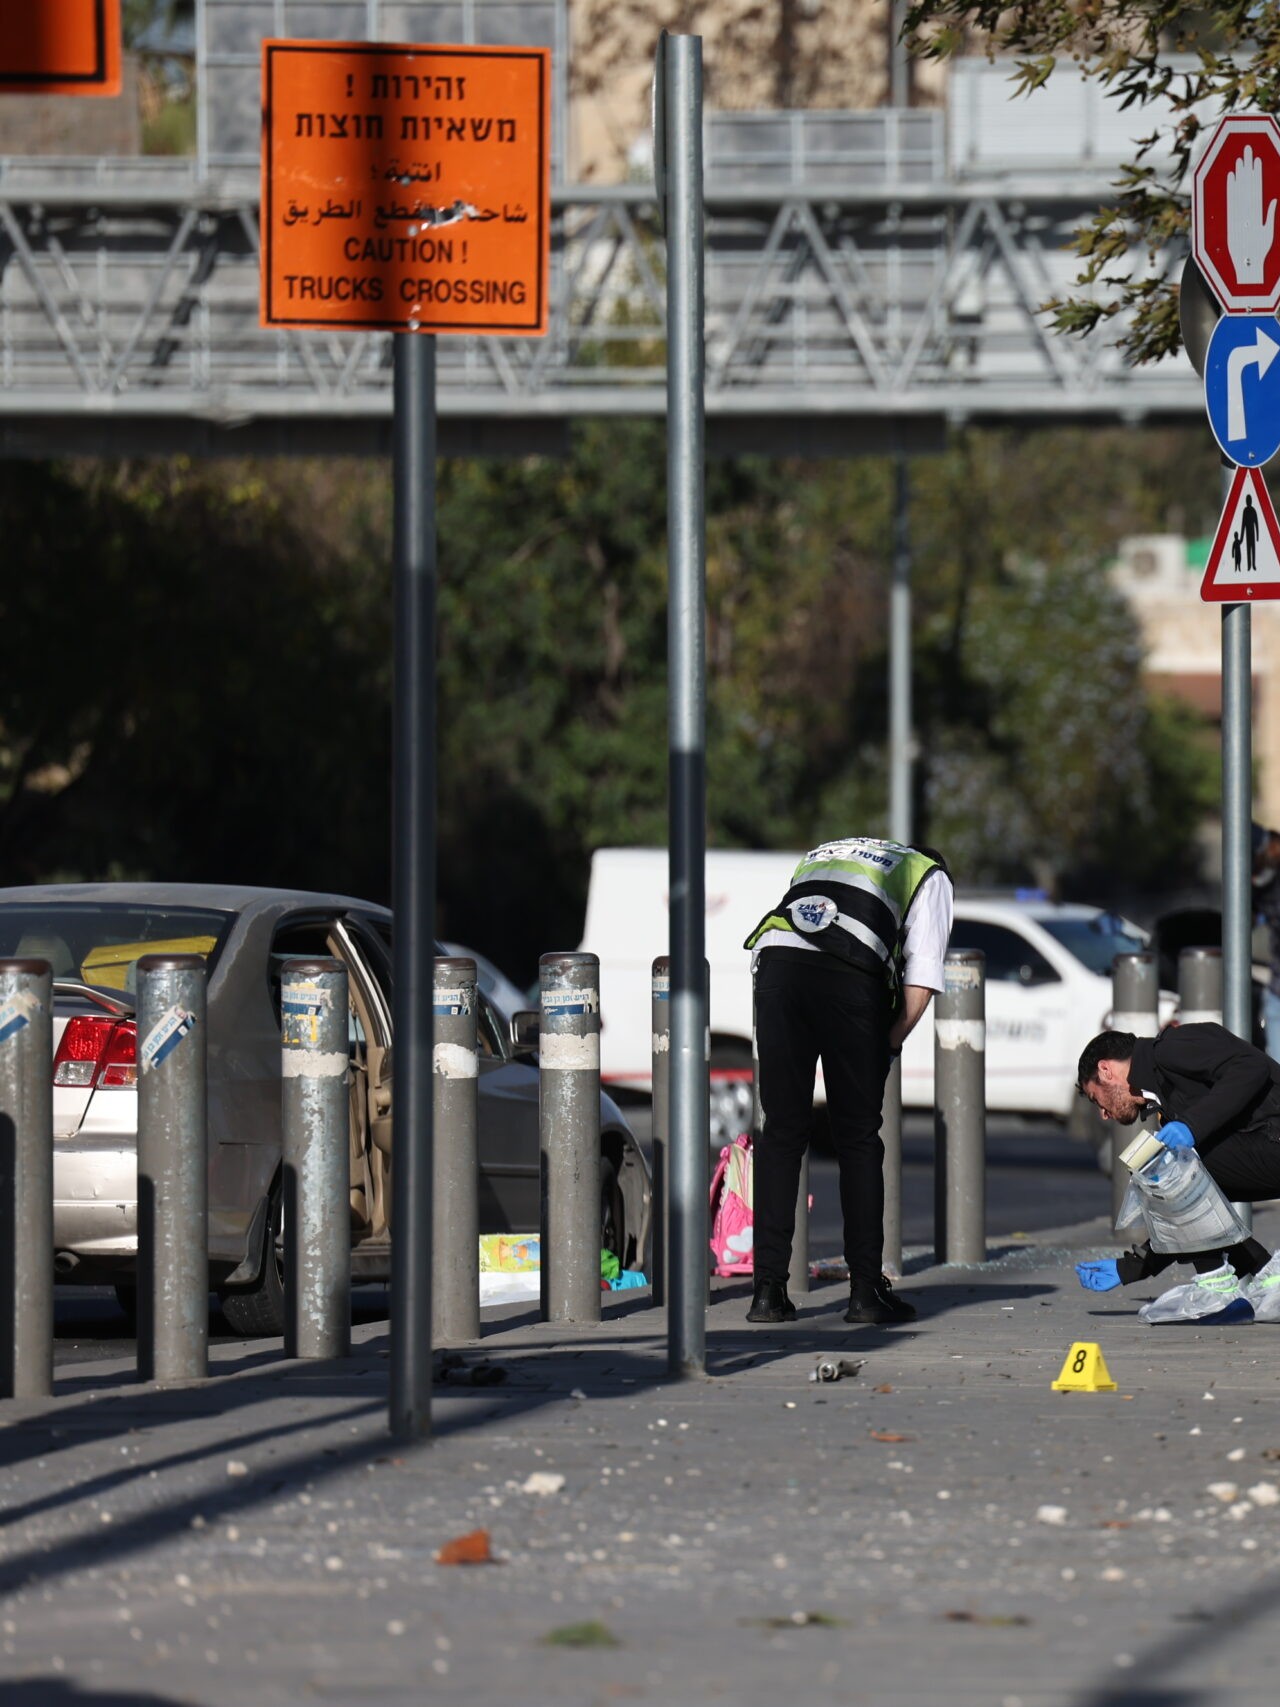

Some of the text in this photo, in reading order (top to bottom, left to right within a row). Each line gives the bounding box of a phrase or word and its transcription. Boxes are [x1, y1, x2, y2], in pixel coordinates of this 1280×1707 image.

[371, 74, 466, 100] זהירות
[295, 113, 516, 142] משאיות חוצות
[282, 199, 362, 226] الطريق
[284, 275, 526, 304] TRUCKS CROSSING
[1073, 1349, 1087, 1373] 8
